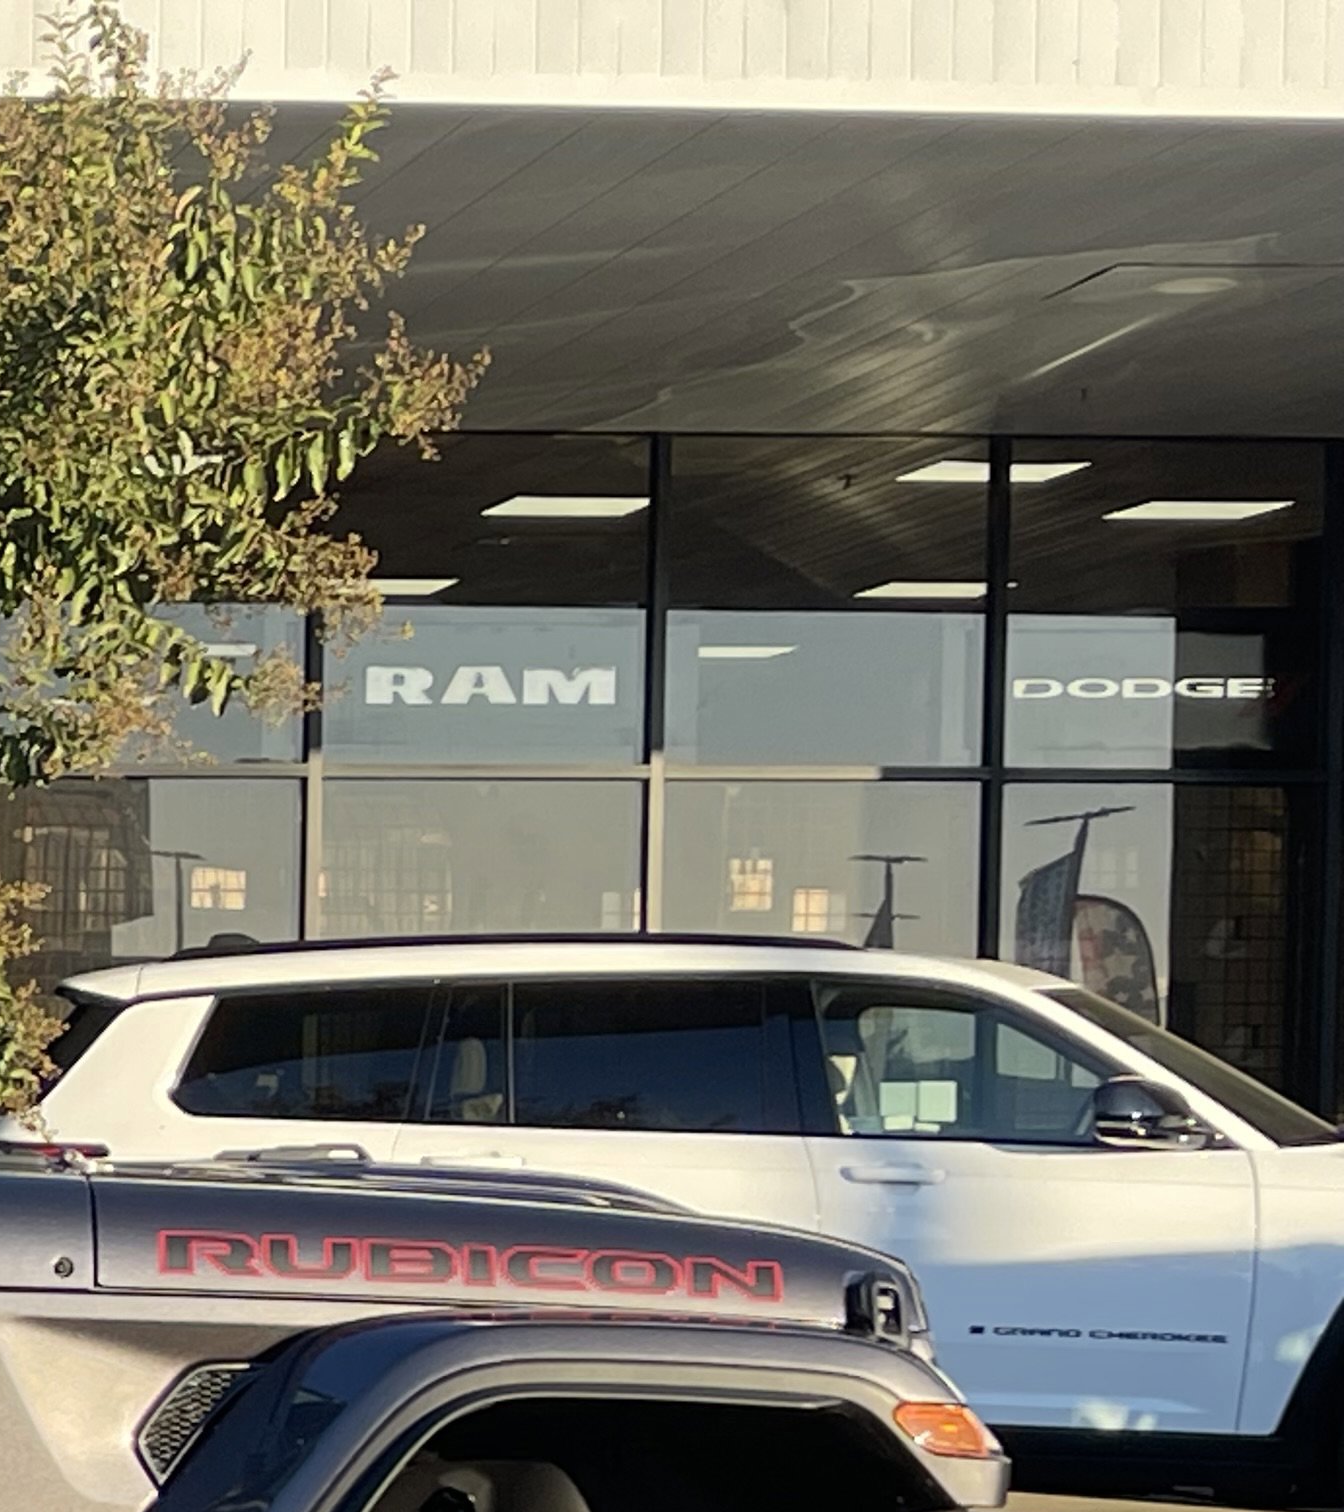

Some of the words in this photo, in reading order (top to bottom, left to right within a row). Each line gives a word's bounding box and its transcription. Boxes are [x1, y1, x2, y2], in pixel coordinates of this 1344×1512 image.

[365, 665, 616, 705] RAM
[1012, 677, 1274, 699] DODGE
[158, 1229, 783, 1302] RUBICON
[993, 1326, 1081, 1338] GRAND
[1088, 1329, 1228, 1343] CHEROKEE
